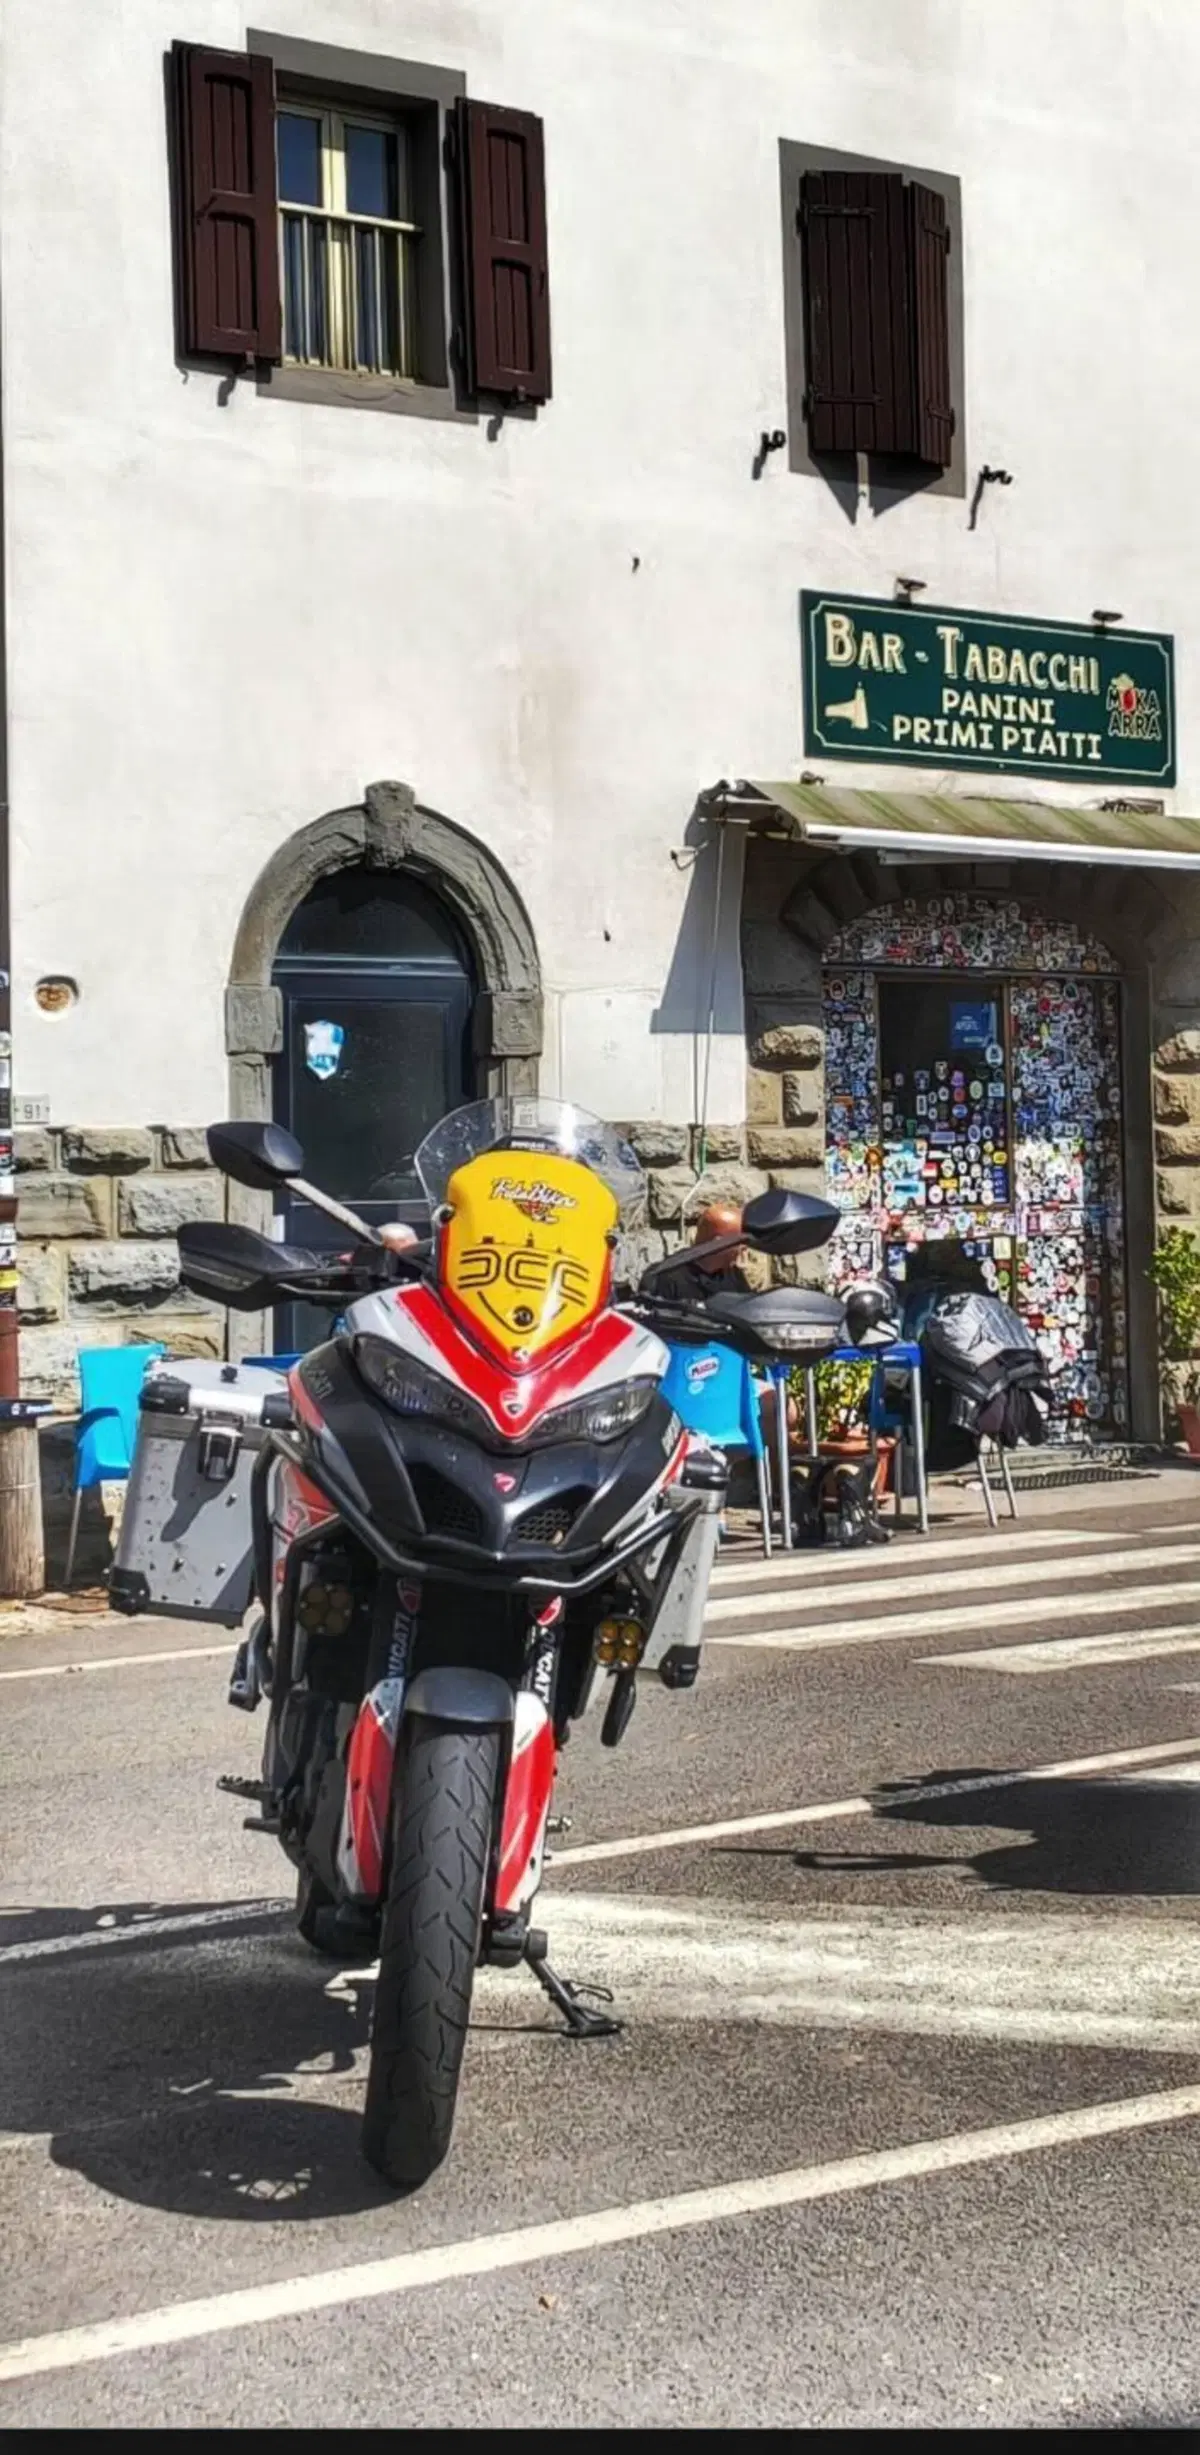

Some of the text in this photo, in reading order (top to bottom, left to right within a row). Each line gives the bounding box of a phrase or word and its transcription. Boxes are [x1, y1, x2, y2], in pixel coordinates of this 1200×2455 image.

[824, 612, 906, 674] BAR
[935, 626, 1101, 695] TABACCHI
[942, 688, 1055, 725] PANINI
[893, 714, 1102, 760] PRIMI PIATTI
[1108, 711, 1162, 741] ARRA
[24, 1104, 41, 1119] 91
